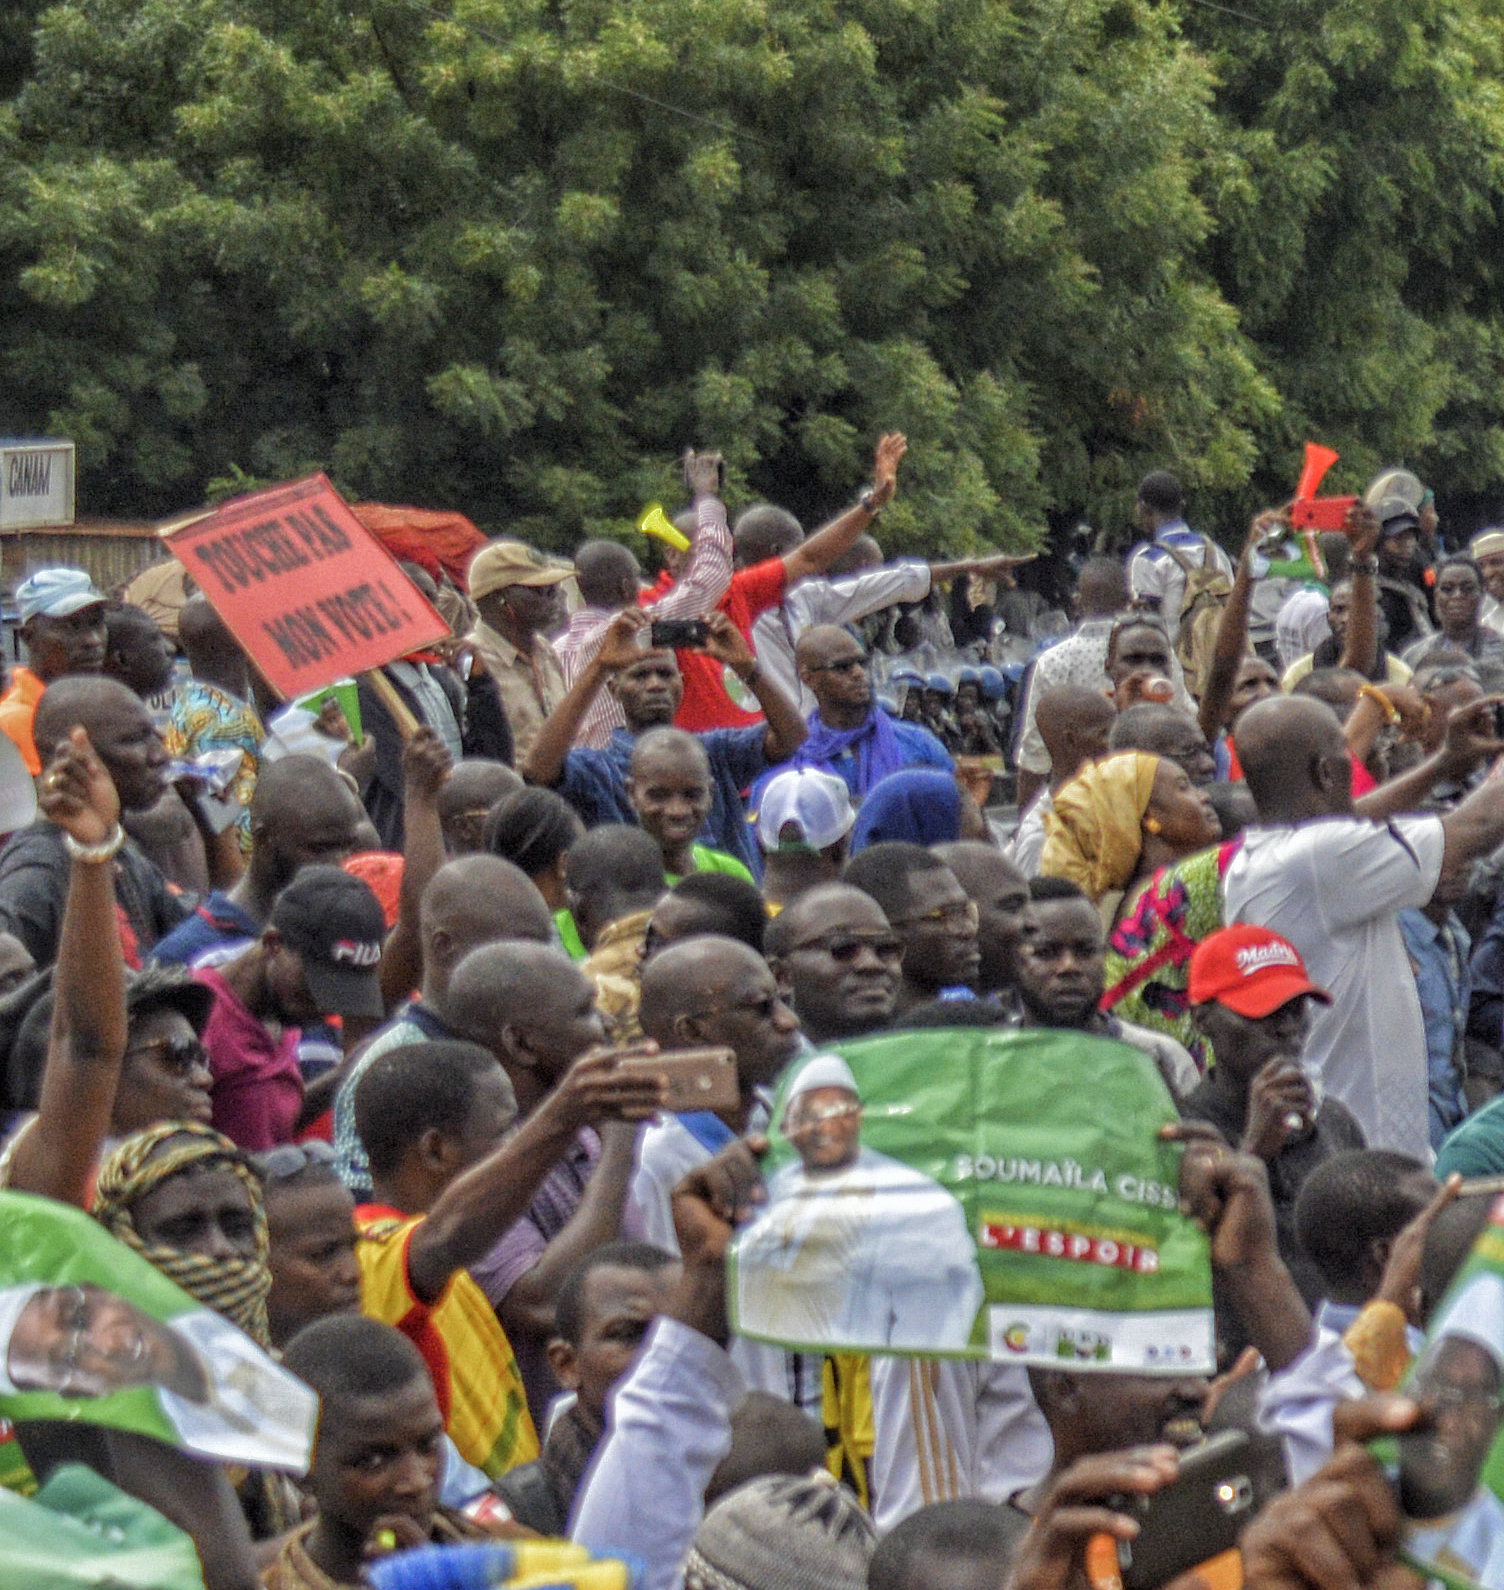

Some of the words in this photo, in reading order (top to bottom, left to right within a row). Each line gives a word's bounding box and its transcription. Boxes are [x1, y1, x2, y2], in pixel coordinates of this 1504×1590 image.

[8, 454, 52, 498] CANAM
[195, 520, 313, 594] TOUCHE
[295, 503, 353, 560] PAS
[262, 602, 336, 670] MON
[324, 583, 400, 645] VOTE
[955, 1152, 1109, 1196] SOUMAÏLA
[981, 1221, 1160, 1275] L'ESPOIR
